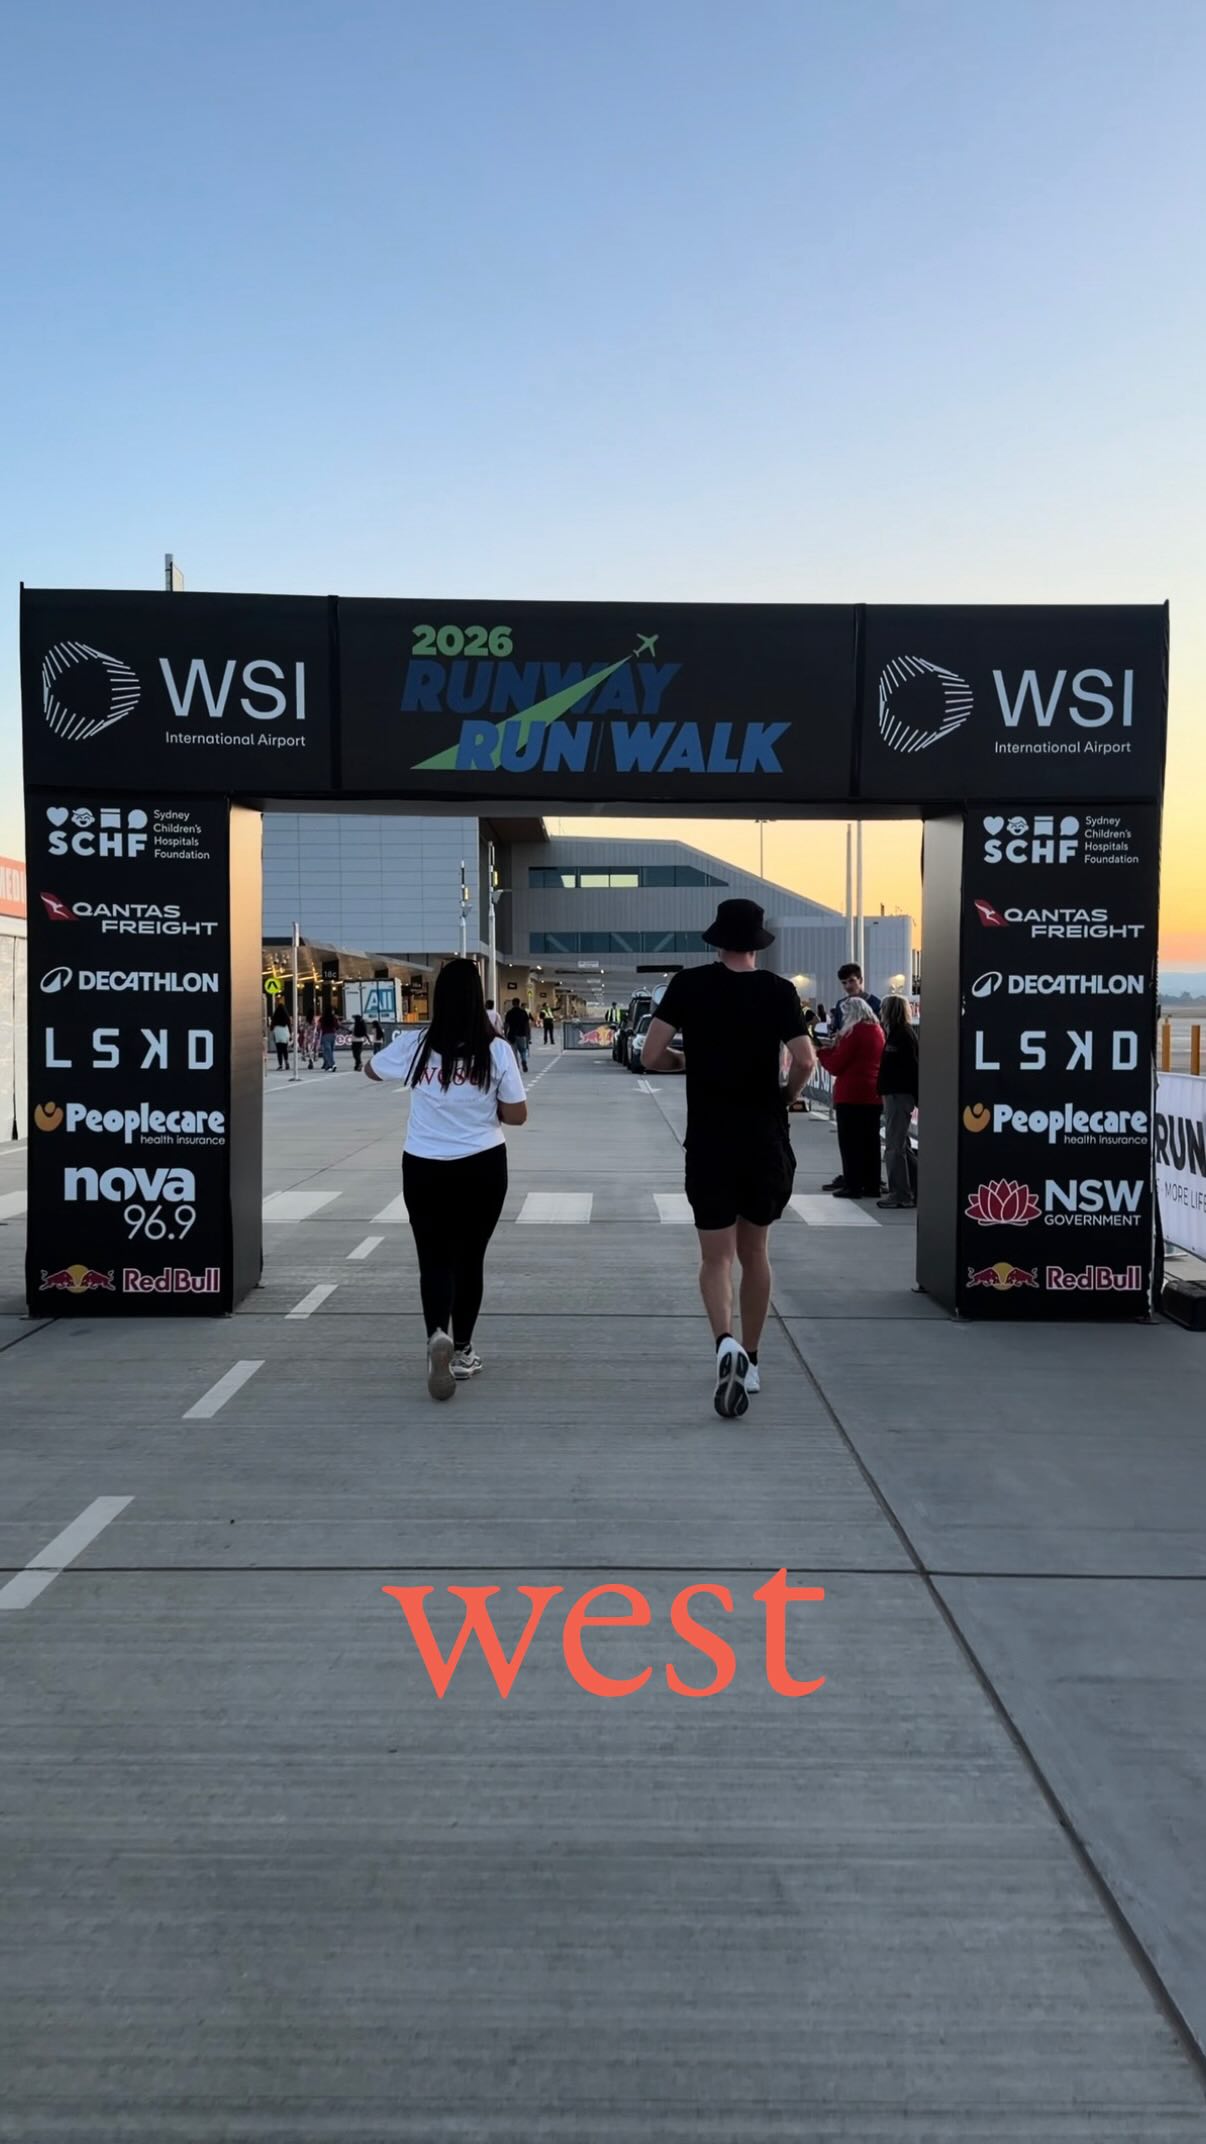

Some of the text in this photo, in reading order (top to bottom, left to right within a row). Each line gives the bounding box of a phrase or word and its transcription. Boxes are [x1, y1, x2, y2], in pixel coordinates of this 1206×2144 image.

[411, 624, 514, 656] 2026
[159, 658, 305, 719] WSI
[400, 660, 682, 714] RUNWAY
[993, 669, 1133, 727] WSI
[166, 732, 305, 748] International Airport
[455, 720, 792, 773] RUN WALK
[995, 741, 1130, 755] International Airport
[154, 810, 189, 821] Sydney
[1086, 816, 1120, 827] Sydney
[153, 823, 201, 833] Children's
[1085, 829, 1131, 838] Children's
[49, 831, 147, 857] SCHF
[154, 836, 199, 847] Hospitals
[1085, 842, 1128, 852] Hospitals
[155, 849, 209, 859] Foundation
[984, 839, 1078, 863] SCHF
[1085, 855, 1138, 863] Foundation
[72, 902, 181, 918] QANTAS
[1003, 908, 1109, 923] QANTAS
[102, 920, 218, 935] FREIGHT
[1032, 925, 1144, 938] FREIGHT
[79, 971, 218, 992] DECATHLON
[1008, 975, 1144, 994] DECATHLON
[66, 1102, 225, 1144] Peoplecare
[993, 1103, 1148, 1144] Peoplecare
[140, 1135, 225, 1145] health insurance
[1063, 1134, 1148, 1145] health insurance
[64, 1167, 195, 1202] nova
[1045, 1180, 1144, 1212] NSW
[124, 1204, 196, 1240] 96.9
[1044, 1215, 1141, 1225] GOVERNMENT
